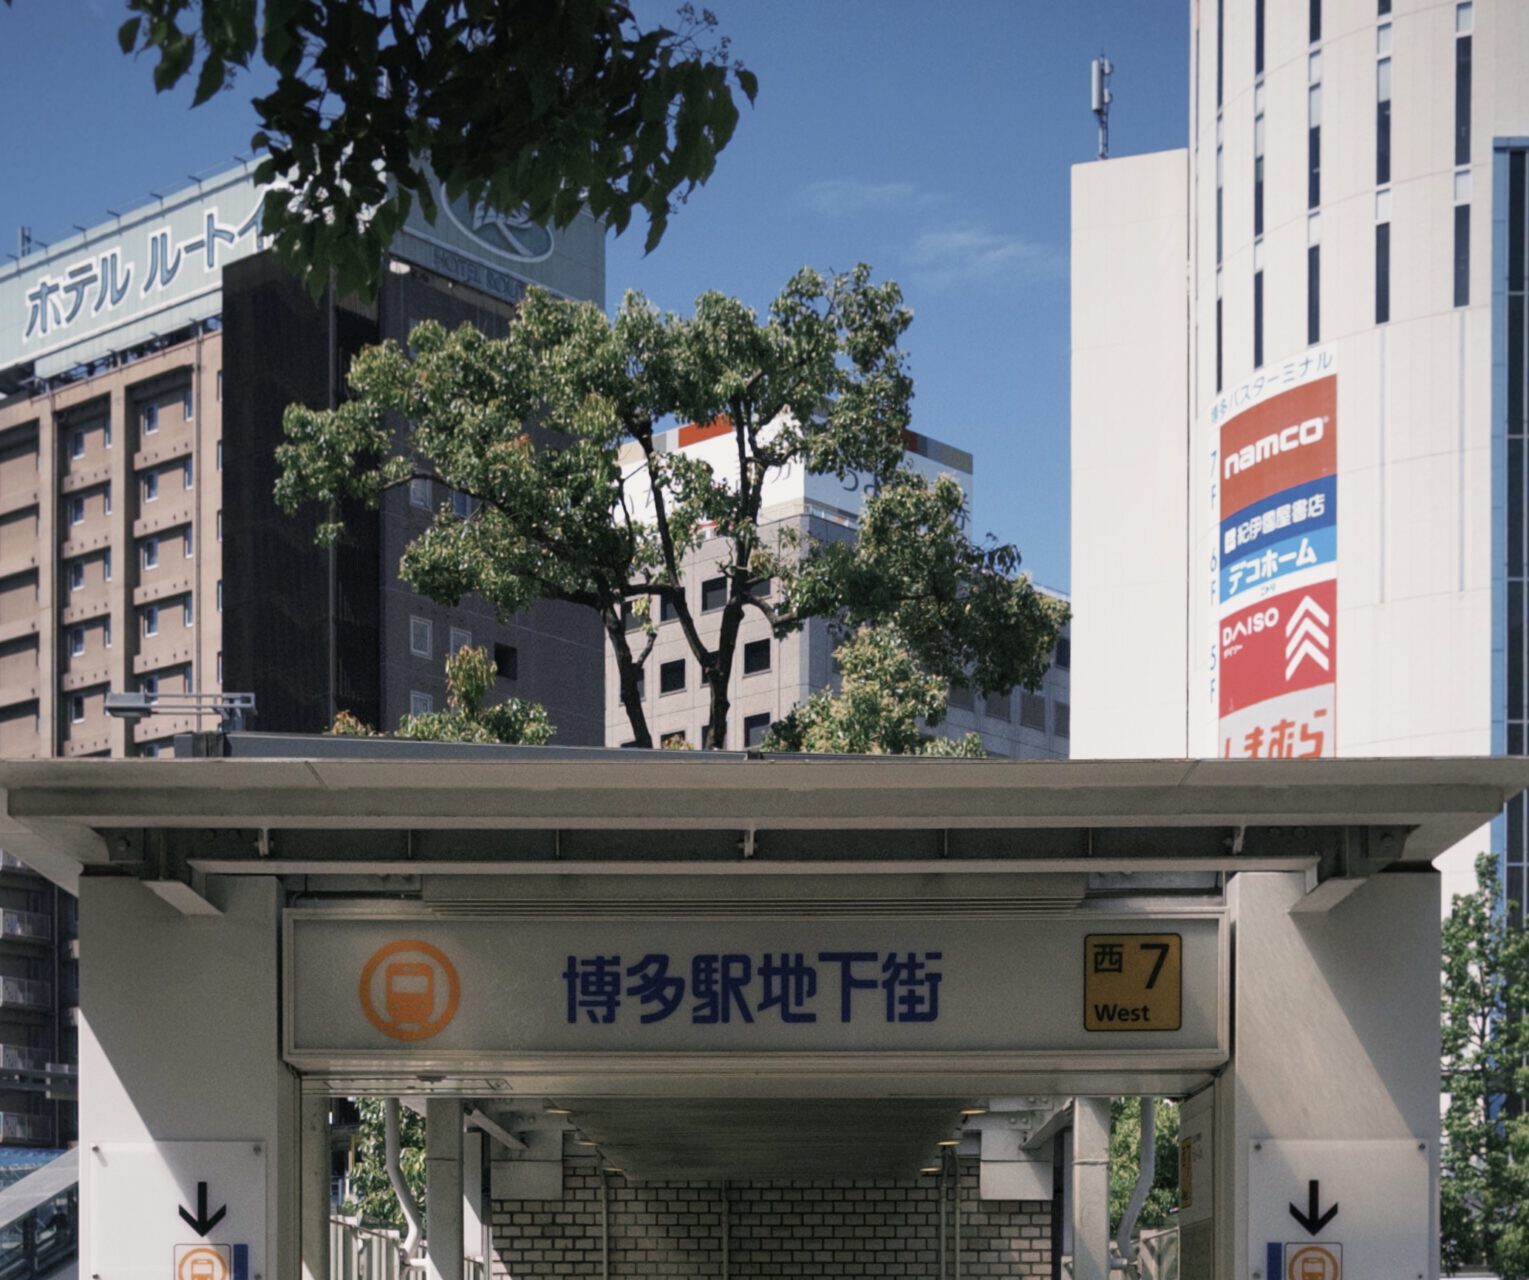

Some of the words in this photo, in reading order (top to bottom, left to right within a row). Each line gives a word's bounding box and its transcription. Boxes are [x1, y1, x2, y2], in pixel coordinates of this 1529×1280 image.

[24, 251, 132, 339] ホテル
[143, 193, 277, 295] ルートイ
[1224, 416, 1325, 480] namco
[1229, 538, 1317, 595] デコホーム
[1222, 606, 1280, 647] DAISO
[562, 951, 943, 1025] 博多駅地下街
[1092, 943, 1124, 974] 西
[1140, 943, 1170, 990] 7
[1094, 1003, 1151, 1022] West
